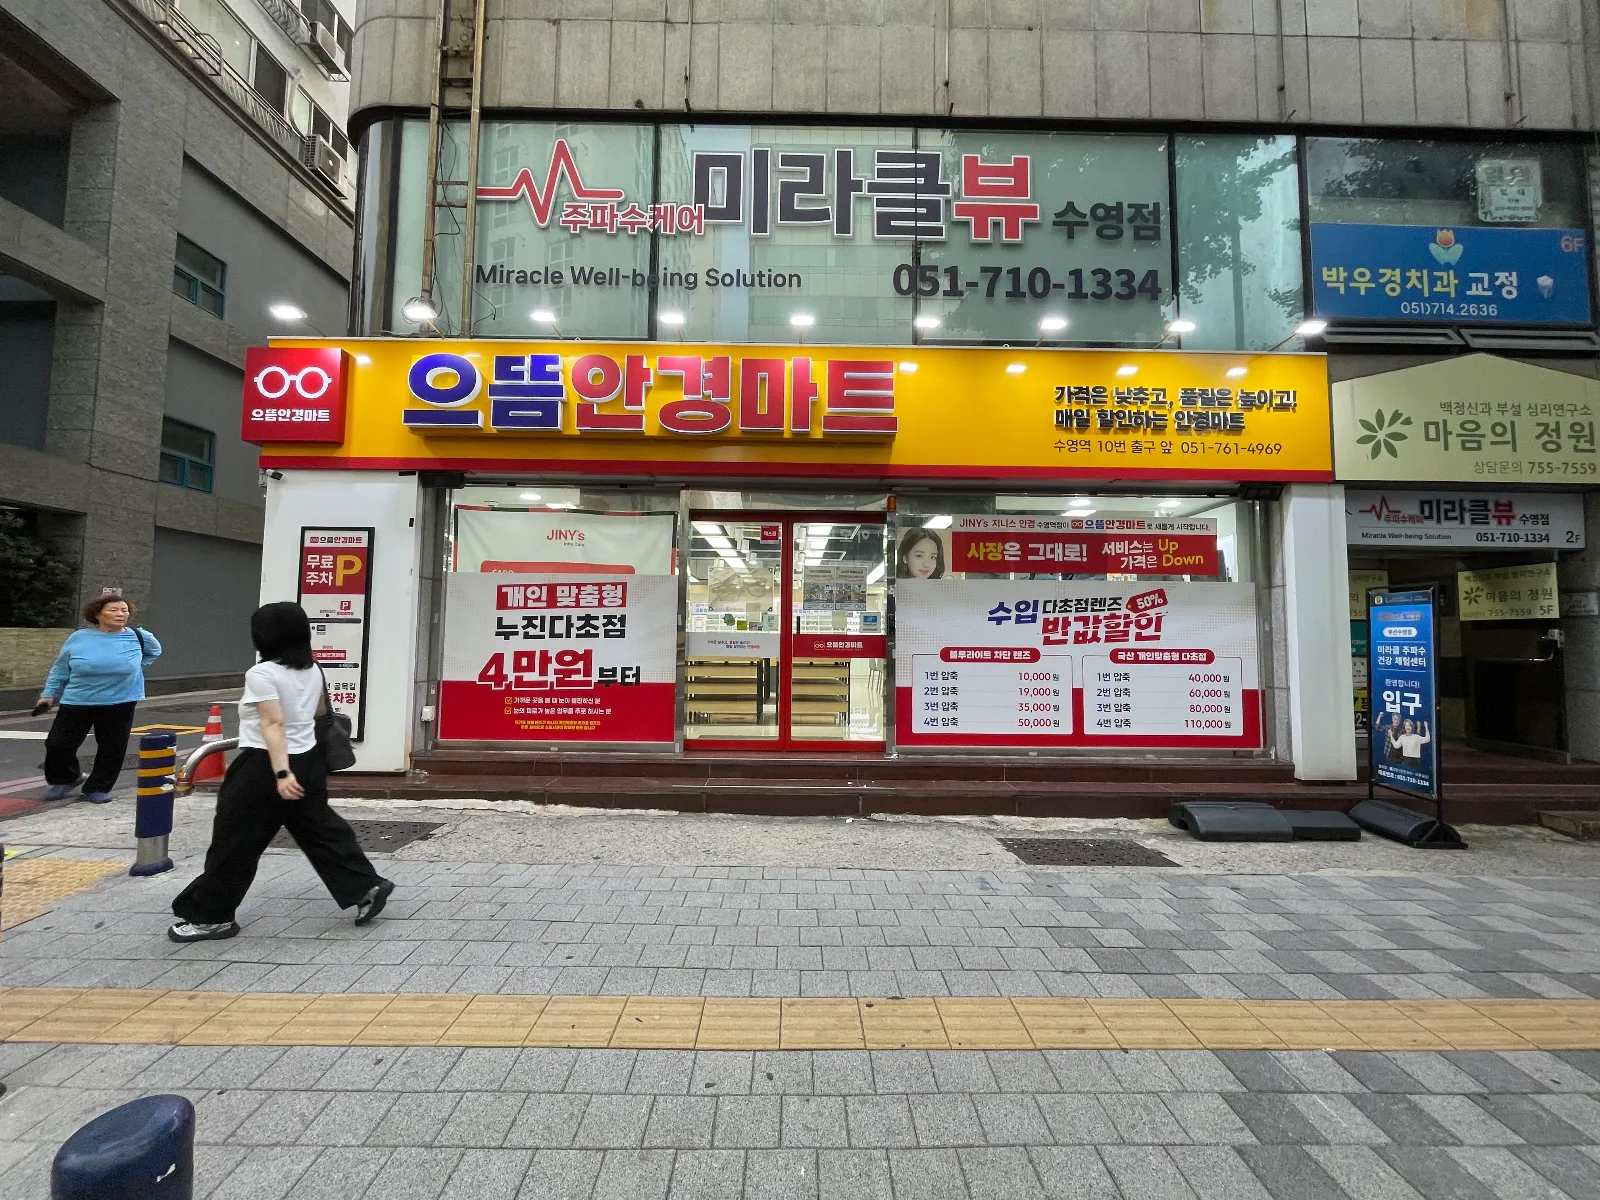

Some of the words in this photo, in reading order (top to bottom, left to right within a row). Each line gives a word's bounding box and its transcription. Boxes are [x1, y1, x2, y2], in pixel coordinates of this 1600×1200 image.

[693, 148, 1040, 240] 미라클뷰
[1052, 201, 1161, 240] 수영점
[560, 203, 704, 235] 주파수케어
[1561, 235, 1586, 252] 6F
[475, 264, 564, 285] Miracle
[570, 265, 698, 290] Well-being
[705, 268, 802, 289] Solution
[893, 264, 1162, 300] 051-710-1334
[1322, 266, 1458, 298] 박우경치과
[1466, 272, 1518, 299] 교정
[1401, 302, 1497, 316] 051)714.2636
[402, 353, 898, 434] 으뜸안경마트
[1054, 386, 1108, 405] 가격은
[1113, 386, 1173, 408] 낮추고,
[1179, 388, 1233, 407] 품질은
[1238, 389, 1297, 409] 높이고!
[251, 408, 330, 421] 으뜸안경마트
[1440, 402, 1491, 415] 백정신과
[1497, 402, 1521, 415] 부설
[1527, 404, 1592, 416] 심리연구소
[1054, 409, 1091, 428] 매일
[1096, 409, 1168, 429] 할인하는
[1173, 411, 1245, 430] 안경마트
[1424, 419, 1517, 452] 마음의
[1535, 421, 1596, 453] 정원
[1054, 439, 1091, 452] 수영역
[1098, 440, 1126, 453] 10번
[1131, 440, 1156, 453] 출구
[1160, 440, 1173, 454] 앞
[1181, 442, 1282, 454] 051-761-4969
[1473, 461, 1522, 474] 상담문의
[1528, 461, 1597, 475] 755-7559
[1420, 498, 1516, 525] 미라클뷰
[1519, 513, 1550, 526] 수영점
[991, 519, 1017, 528] 지니스
[1019, 519, 1036, 529] 안경
[1388, 532, 1423, 540] Well-being
[1476, 532, 1550, 543] 051-710-1334
[1566, 531, 1581, 544] 2F
[967, 542, 1021, 561] 사장은
[1028, 542, 1087, 562] 그대로!
[1101, 540, 1153, 555] 서비스는
[1158, 538, 1179, 553] Up
[306, 554, 334, 569] 무료
[1120, 554, 1157, 569] 가격은
[1162, 554, 1204, 567] Down
[335, 554, 362, 586] P
[305, 571, 334, 586] 주차
[502, 586, 547, 607] 개인
[556, 585, 622, 607] 맞춤형
[1137, 593, 1163, 610] 50%
[1485, 590, 1521, 603] 마음의
[1528, 588, 1554, 601] 정원
[988, 600, 1039, 625] 수입
[1042, 597, 1123, 614] 다초점렌즈
[1488, 608, 1532, 617] 755-7559
[1540, 605, 1554, 616] 5F
[495, 614, 626, 640] 누진다초점
[1041, 612, 1168, 646] 반값할인
[993, 650, 1012, 660] 차단
[1013, 651, 1031, 660] 렌즈
[1117, 651, 1135, 661] 국산
[1181, 652, 1207, 661] 다초점
[1377, 645, 1400, 655] 미라클
[1402, 646, 1426, 656] 주파수
[1377, 656, 1393, 666] 건강
[1394, 657, 1427, 667] 체험센터
[924, 671, 939, 681] 1번
[941, 671, 959, 681] 압축
[1096, 672, 1111, 682] 1번
[1113, 672, 1132, 682] 압축
[924, 686, 939, 696] 2번
[941, 686, 959, 696] 압축
[1096, 688, 1111, 698] 2번
[1113, 688, 1132, 698] 압축
[924, 702, 939, 712] 3번
[941, 702, 959, 712] 압축
[1096, 703, 1111, 713] 3번
[1113, 703, 1132, 713] 압축
[1382, 690, 1422, 716] 입구
[924, 717, 939, 727] 4번
[941, 717, 959, 727] 압축
[1096, 718, 1111, 729] 4번
[1113, 718, 1132, 729] 압축
